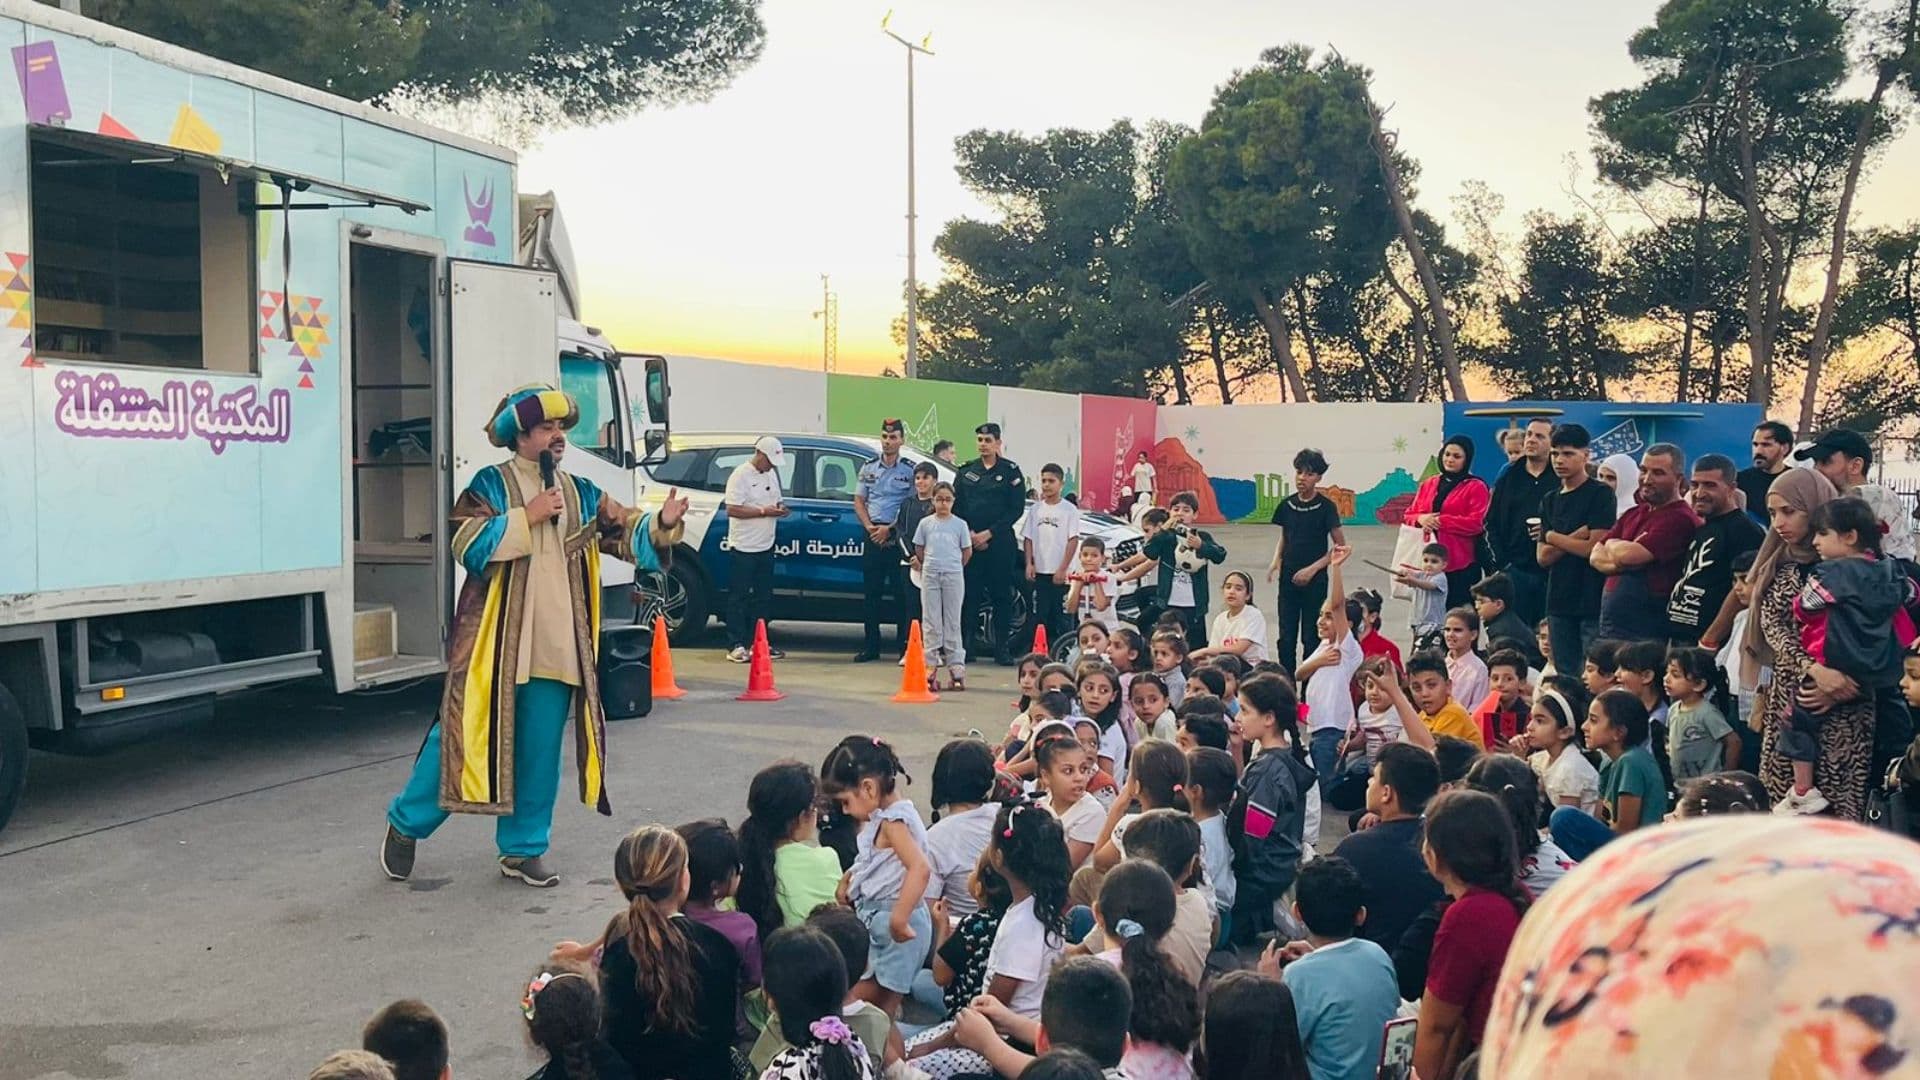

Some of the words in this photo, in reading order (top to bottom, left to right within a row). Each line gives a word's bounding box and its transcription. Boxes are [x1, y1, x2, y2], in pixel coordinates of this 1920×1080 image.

[58, 373, 186, 437] المتنقلة
[193, 383, 288, 452] المكتبة
[806, 538, 865, 559] لشرطة
